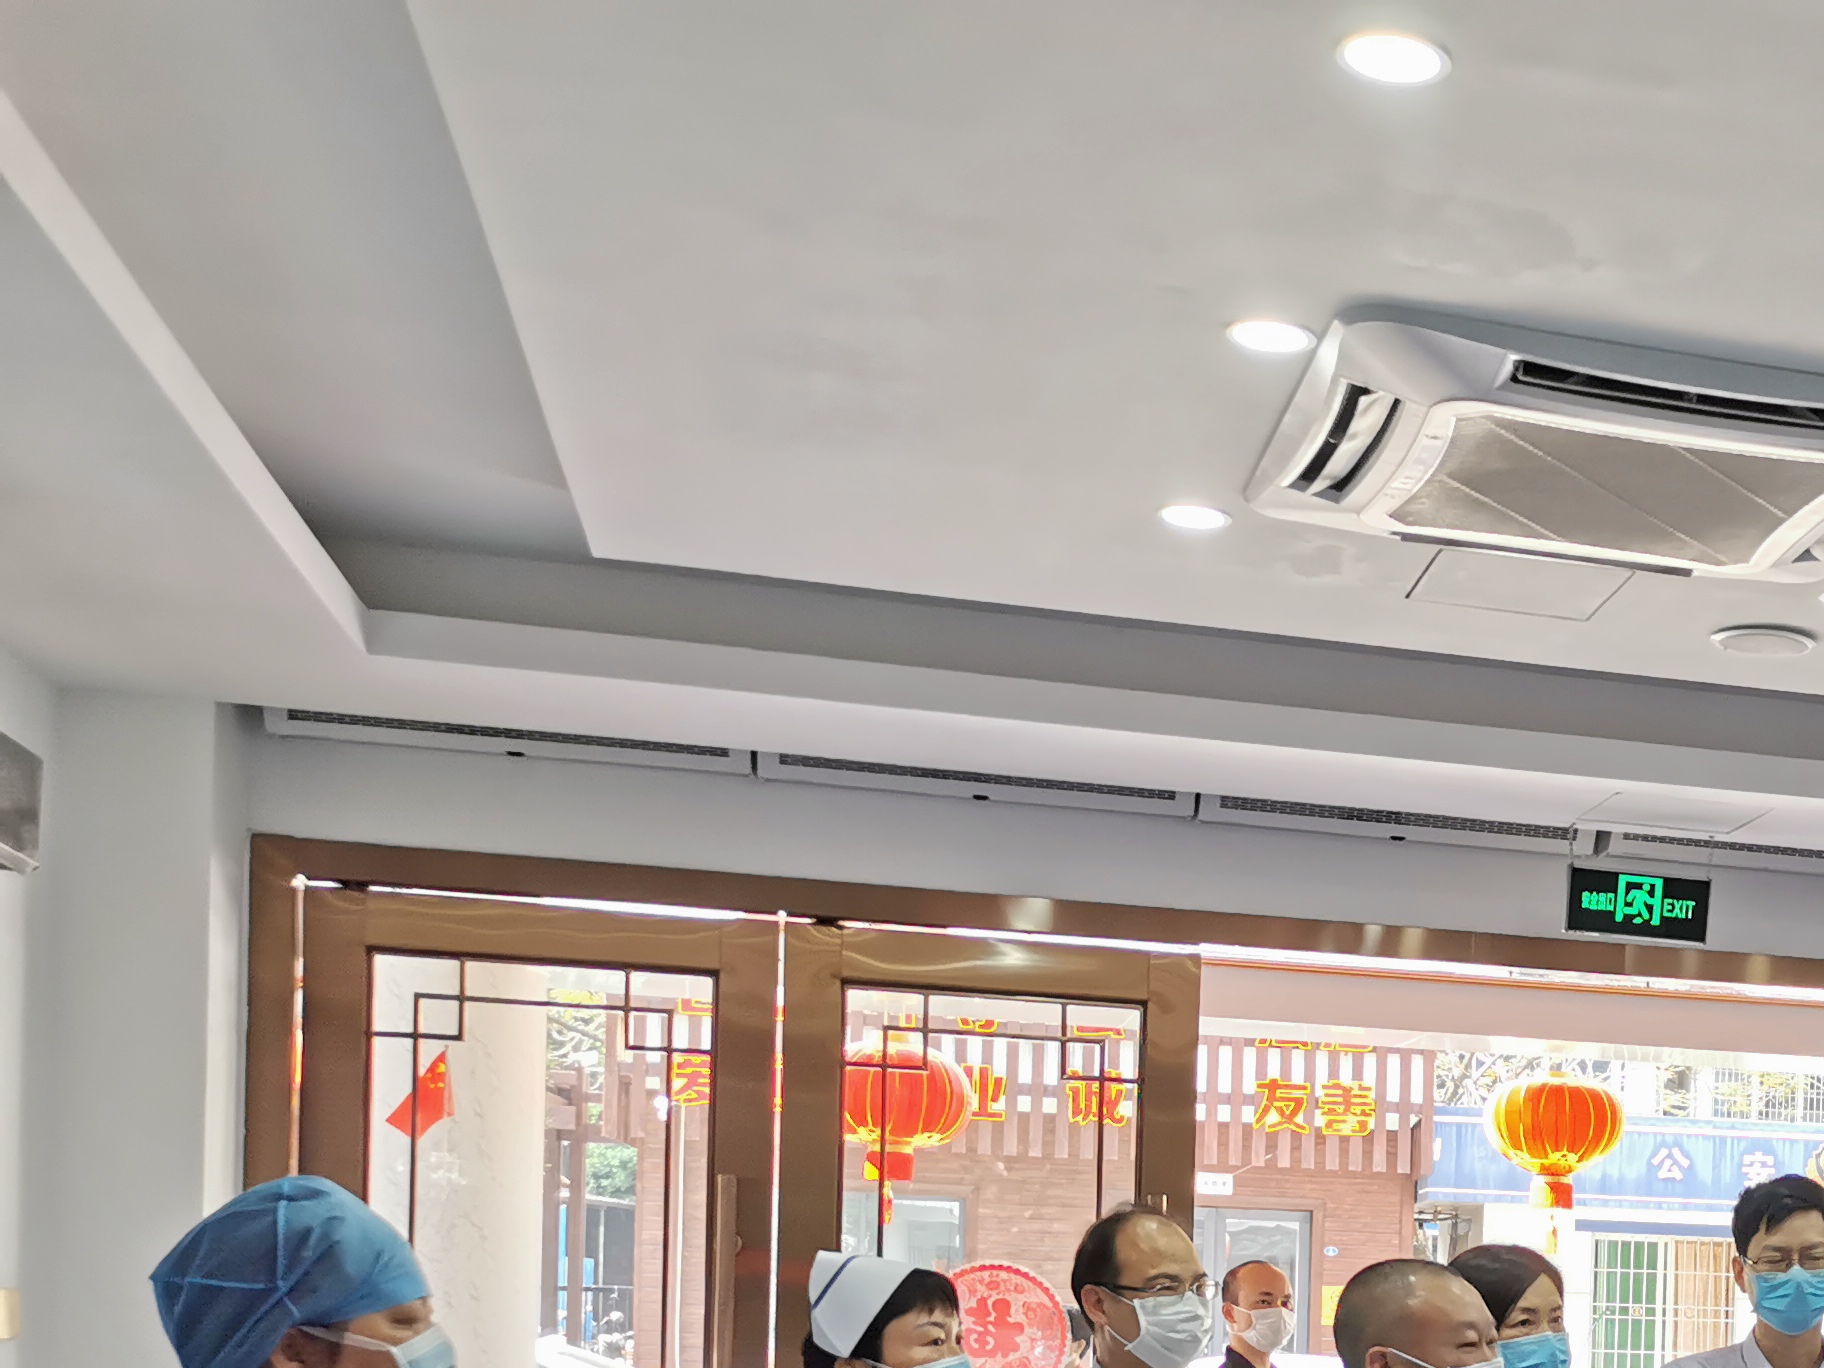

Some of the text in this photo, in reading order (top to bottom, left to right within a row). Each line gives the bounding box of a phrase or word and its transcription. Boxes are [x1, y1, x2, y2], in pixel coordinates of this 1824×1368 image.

[1663, 898, 1696, 919] EXIT
[1066, 1069, 1129, 1128] 诚
[1252, 1077, 1377, 1138] 友善
